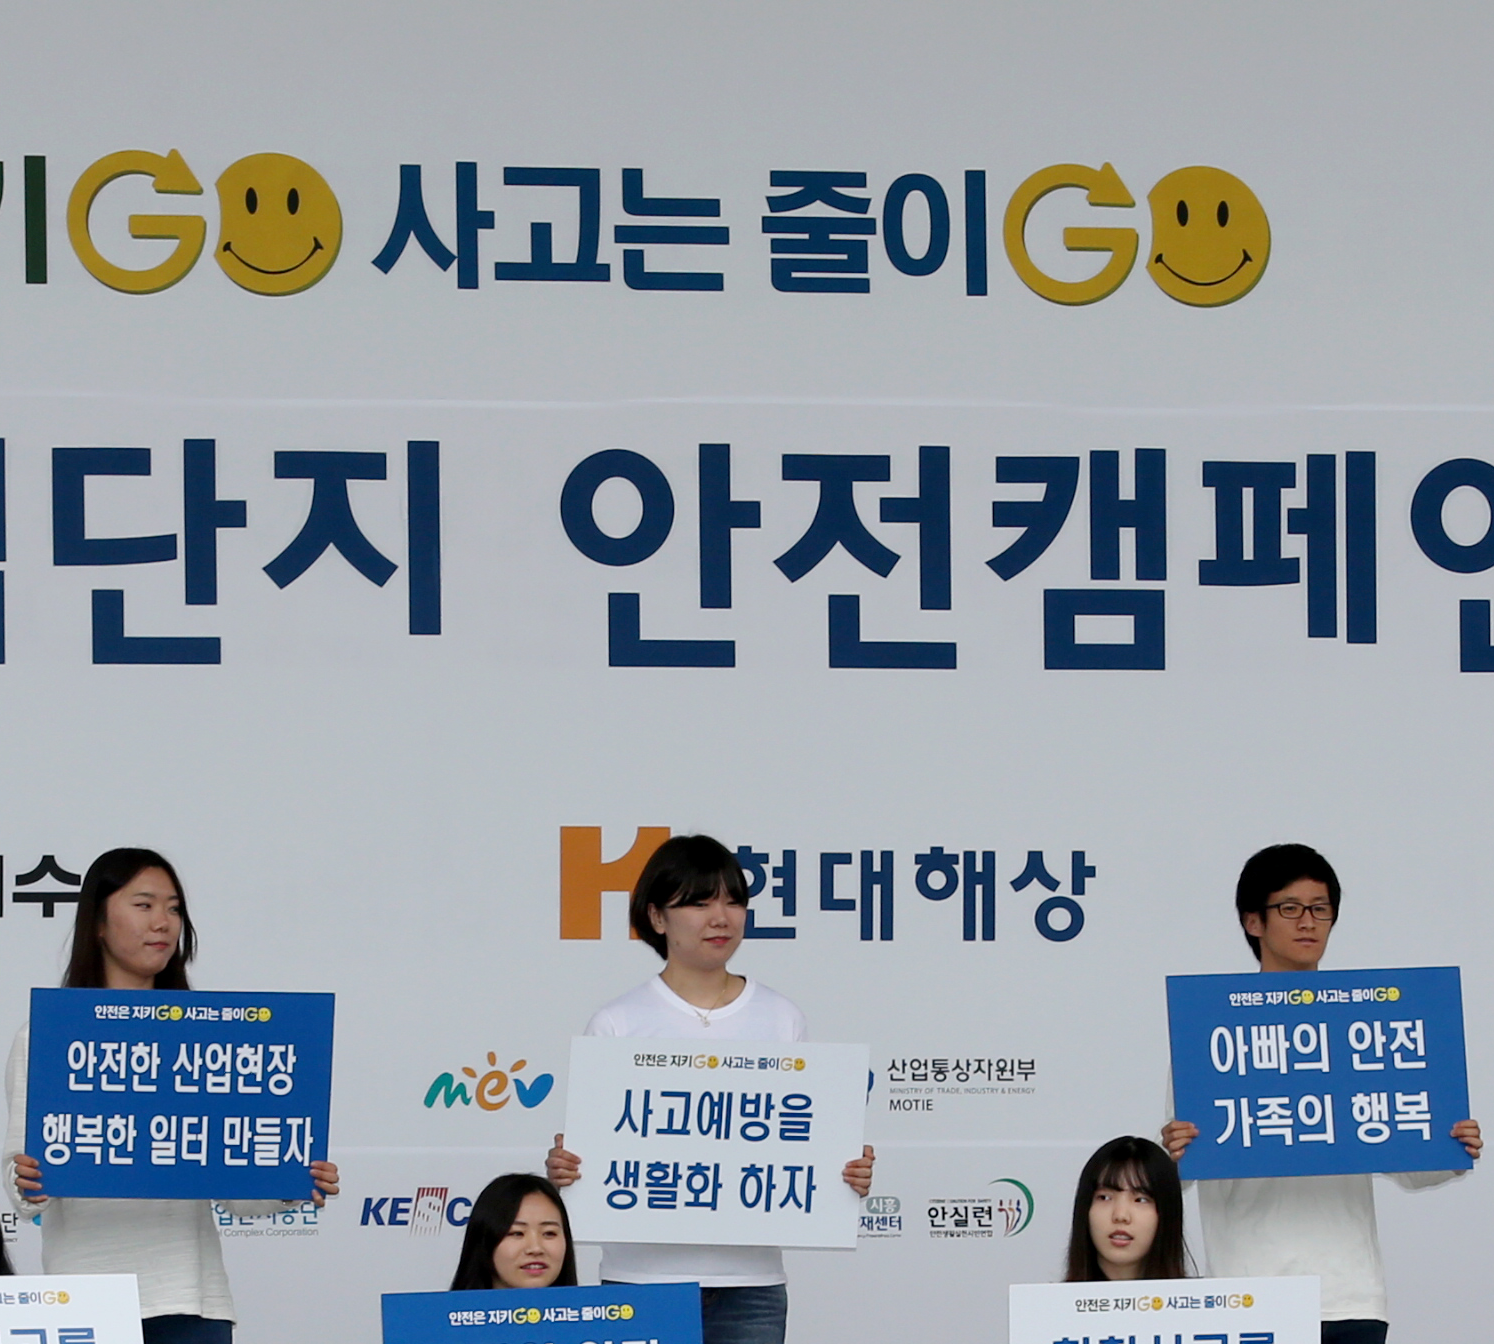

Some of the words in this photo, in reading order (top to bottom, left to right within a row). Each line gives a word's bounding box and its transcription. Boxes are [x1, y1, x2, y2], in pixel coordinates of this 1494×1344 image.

[371, 161, 730, 291] 사고는
[737, 846, 1097, 942] 현대해상
[1229, 991, 1263, 1007] 안전은
[1315, 988, 1351, 1004] 사고는
[94, 1005, 130, 1019] 안전은
[184, 1005, 221, 1021] 사고는
[1209, 1023, 1330, 1075] 아빠의
[1348, 1020, 1427, 1070] 안전
[68, 1041, 161, 1092] 안전한
[172, 1043, 296, 1095] 산업현장
[634, 1054, 667, 1067] 안전은
[721, 1056, 755, 1069] 사고는
[887, 1058, 1036, 1082] 산업통상자원부
[614, 1089, 813, 1142] 사고예방을
[889, 1099, 933, 1111] MOTIE
[1214, 1094, 1334, 1147] 가족의
[1351, 1091, 1431, 1143] 행복
[43, 1113, 137, 1165] 행복한
[150, 1115, 208, 1166] 일터
[223, 1116, 314, 1167] 만들자
[603, 1160, 723, 1211] 생활화
[740, 1164, 817, 1214] 하자
[360, 1188, 472, 1234] KESC
[870, 1199, 897, 1213] 시흥
[928, 1206, 992, 1228] 안실련
[224, 1229, 264, 1238] Complex
[266, 1228, 319, 1237] Corporation
[858, 1216, 901, 1231] 재센터
[1075, 1299, 1110, 1312] 안전은
[1166, 1296, 1201, 1309] 사고는
[449, 1310, 487, 1327] 안전은
[543, 1307, 580, 1324] 사고는
